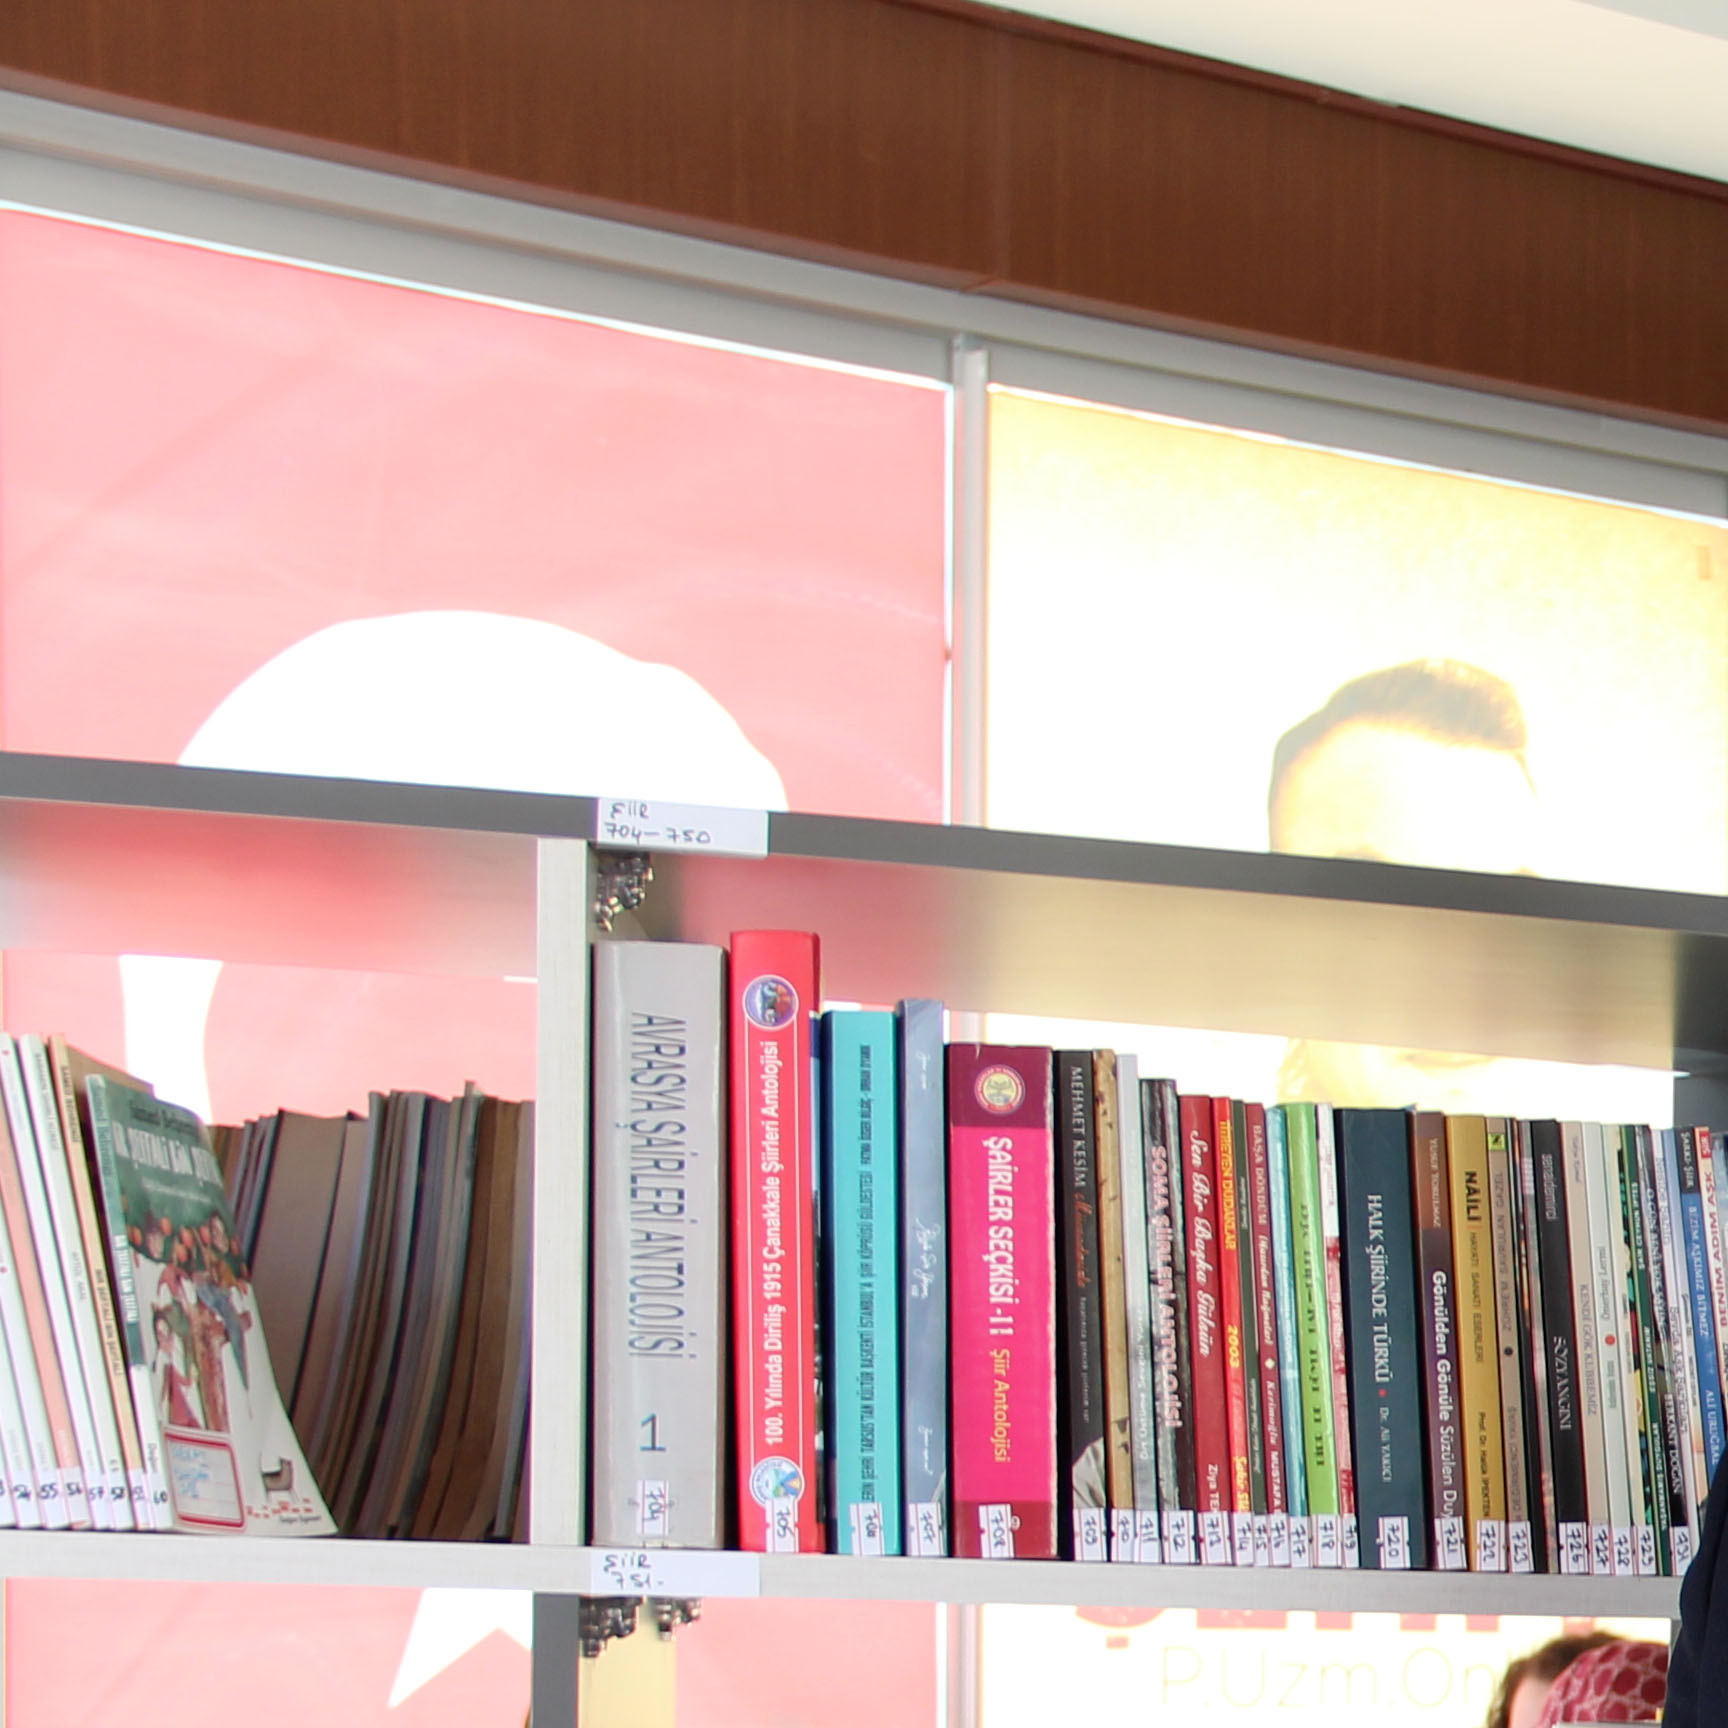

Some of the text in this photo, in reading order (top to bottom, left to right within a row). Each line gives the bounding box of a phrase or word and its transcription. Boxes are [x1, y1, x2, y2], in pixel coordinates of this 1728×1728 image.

[1070, 1065, 1086, 1136] MEHMET
[982, 1135, 1019, 1222] ŞAİRLER
[1072, 1138, 1090, 1188] KESİM
[1151, 1145, 1169, 1216] SOMA
[1189, 1129, 1209, 1162] Sen
[1192, 1172, 1212, 1213] Bir
[1366, 1194, 1383, 1241] HALK
[615, 1011, 698, 1453] AVRASYA ŞAİRLERİ ANTOLOJİSİ 1
[760, 1041, 787, 1446] 100. Yılında Diriliş 1915 Çanakkale Şiirleri Antolojisi
[982, 1227, 1020, 1304] SEÇKİSİ
[1193, 1216, 1214, 1289] Başka
[1704, 1171, 1728, 1327] BENİM ADIM AŞK
[1365, 1243, 1389, 1319] ŞİİRİNDE
[989, 1347, 1012, 1377] Şiir
[1227, 1325, 1241, 1369] 2003
[1372, 1323, 1394, 1383] TÜRKÜ
[1432, 1270, 1457, 1486] Gönülden Gönüle Süzülen
[990, 1379, 1012, 1463] Antolojisi
[1663, 1393, 1682, 1495] BERKANT DOĞAN
[1207, 1464, 1220, 1490] Ziya
